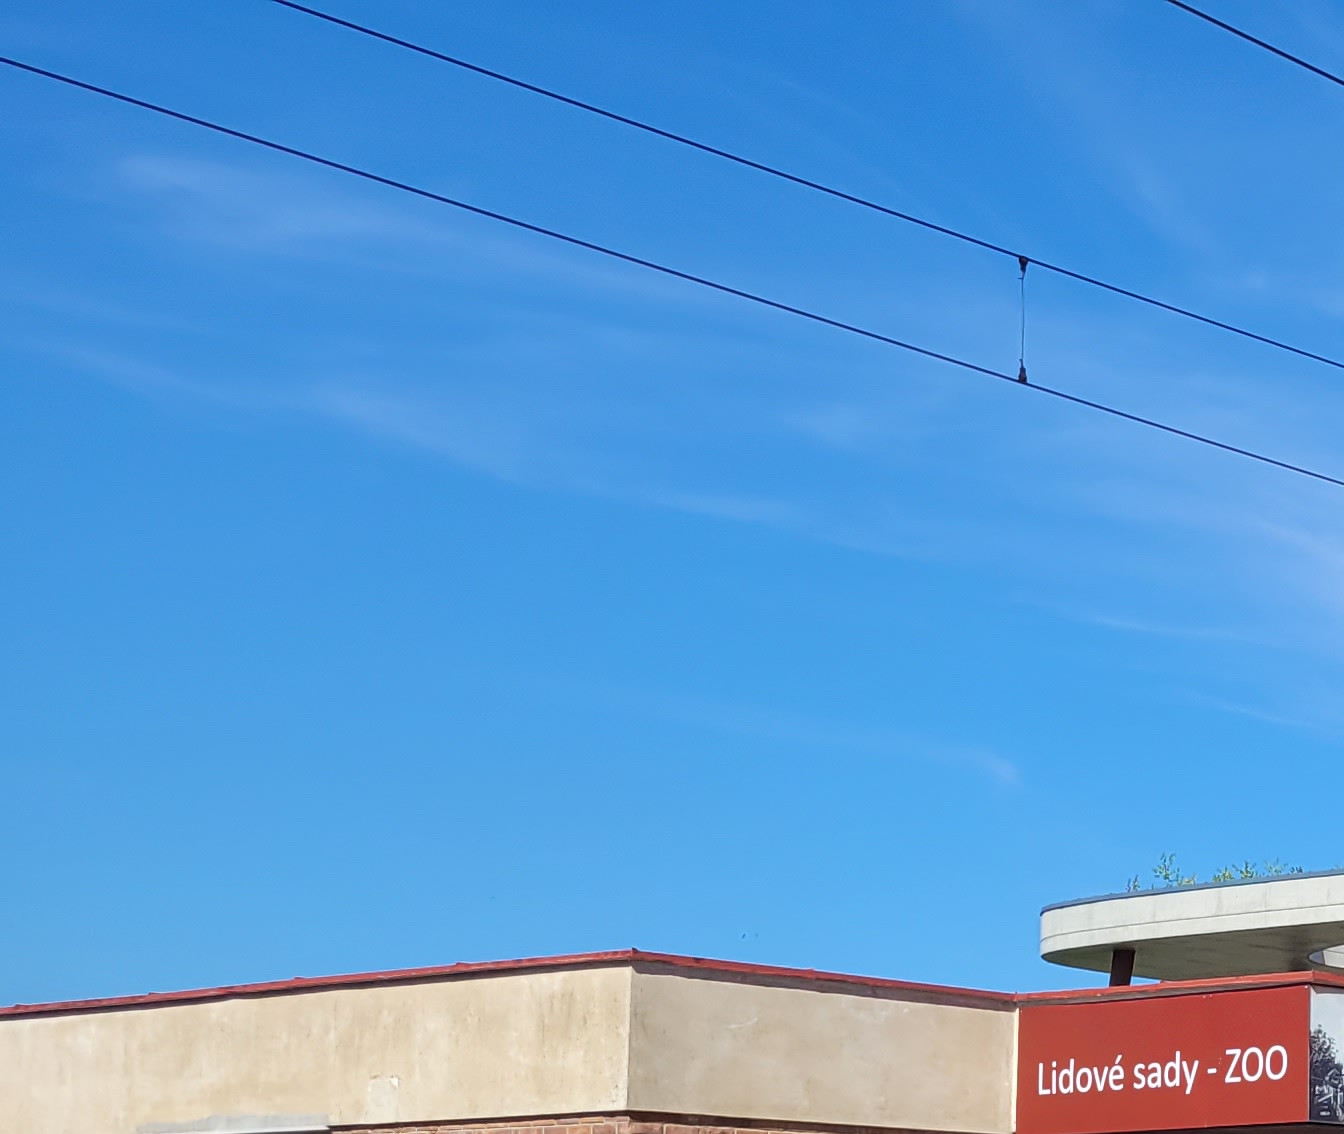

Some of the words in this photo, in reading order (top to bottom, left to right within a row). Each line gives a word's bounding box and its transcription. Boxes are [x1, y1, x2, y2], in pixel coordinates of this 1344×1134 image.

[1038, 1054, 1125, 1095] Lidové
[1133, 1051, 1199, 1094] sady
[1224, 1045, 1288, 1083] ZOO
